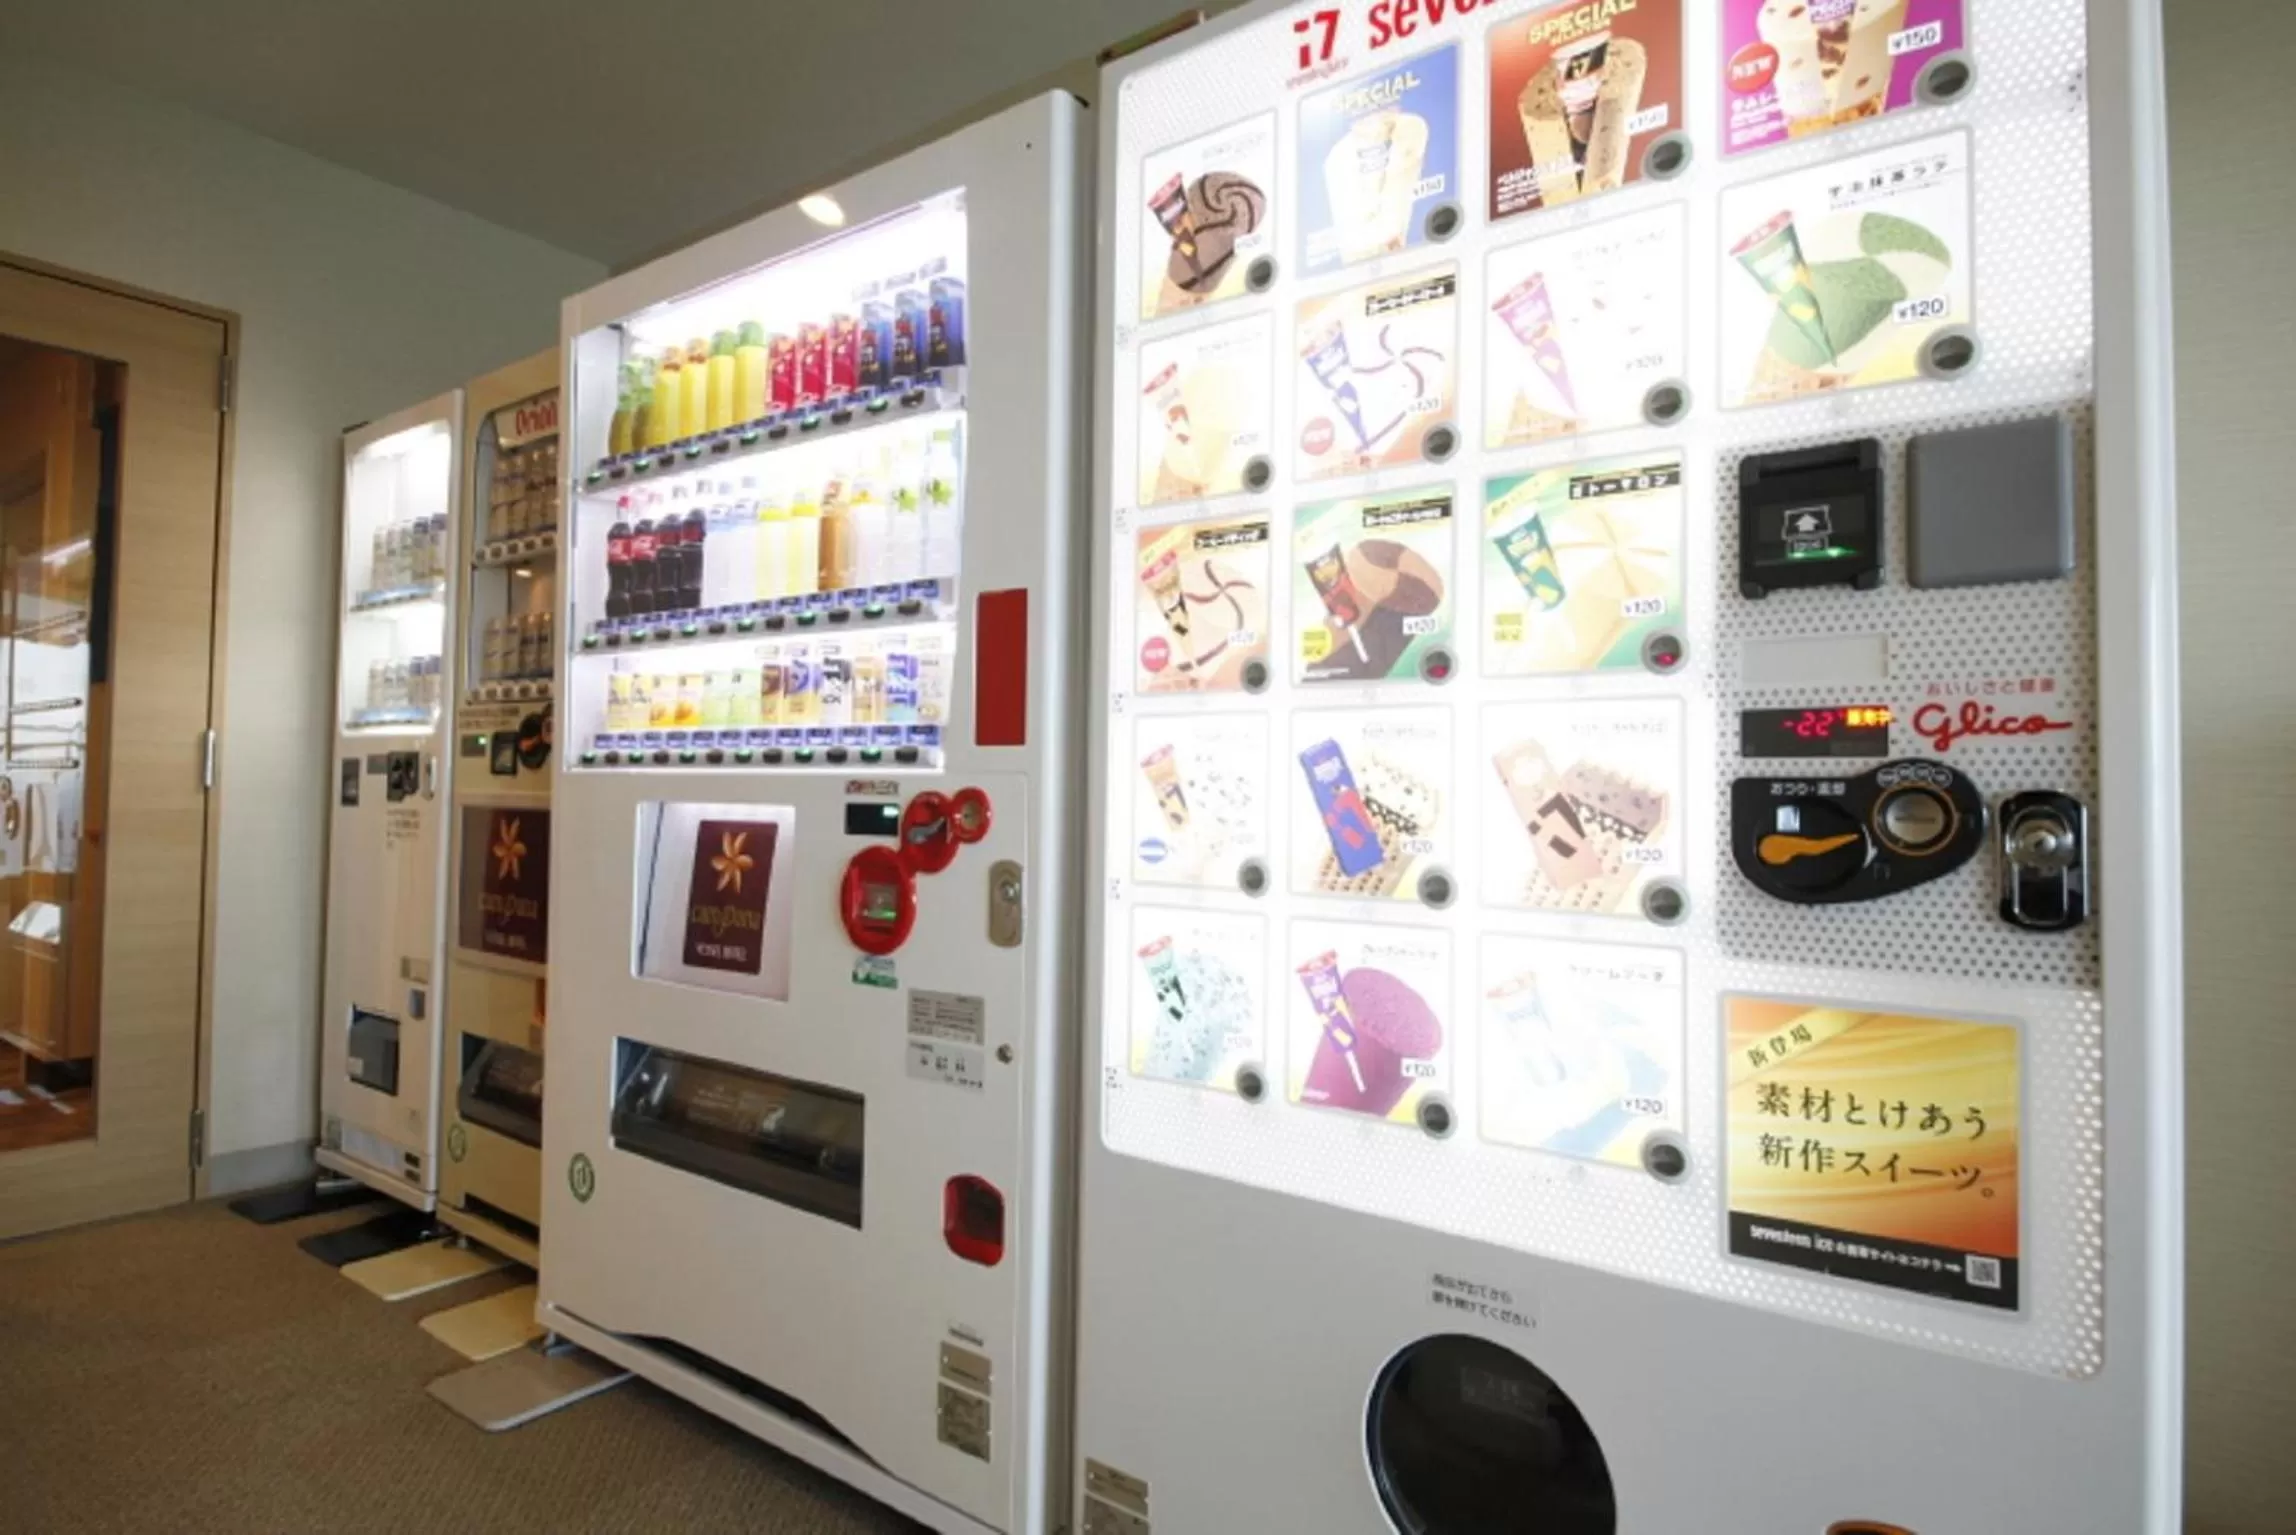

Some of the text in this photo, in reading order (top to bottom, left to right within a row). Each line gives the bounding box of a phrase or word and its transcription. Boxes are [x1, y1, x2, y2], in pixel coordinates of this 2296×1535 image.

[1890, 27, 1938, 49] ¥150
[1898, 297, 1945, 320] ¥120
[1913, 700, 2074, 752] Glico
[1625, 847, 1664, 864] ¥120
[1746, 1022, 1813, 1069] 新登場
[1625, 1095, 1663, 1116] ¥120
[1757, 1081, 1988, 1142] 素材とけあう
[1758, 1132, 1996, 1200] 新作スイーツ。
